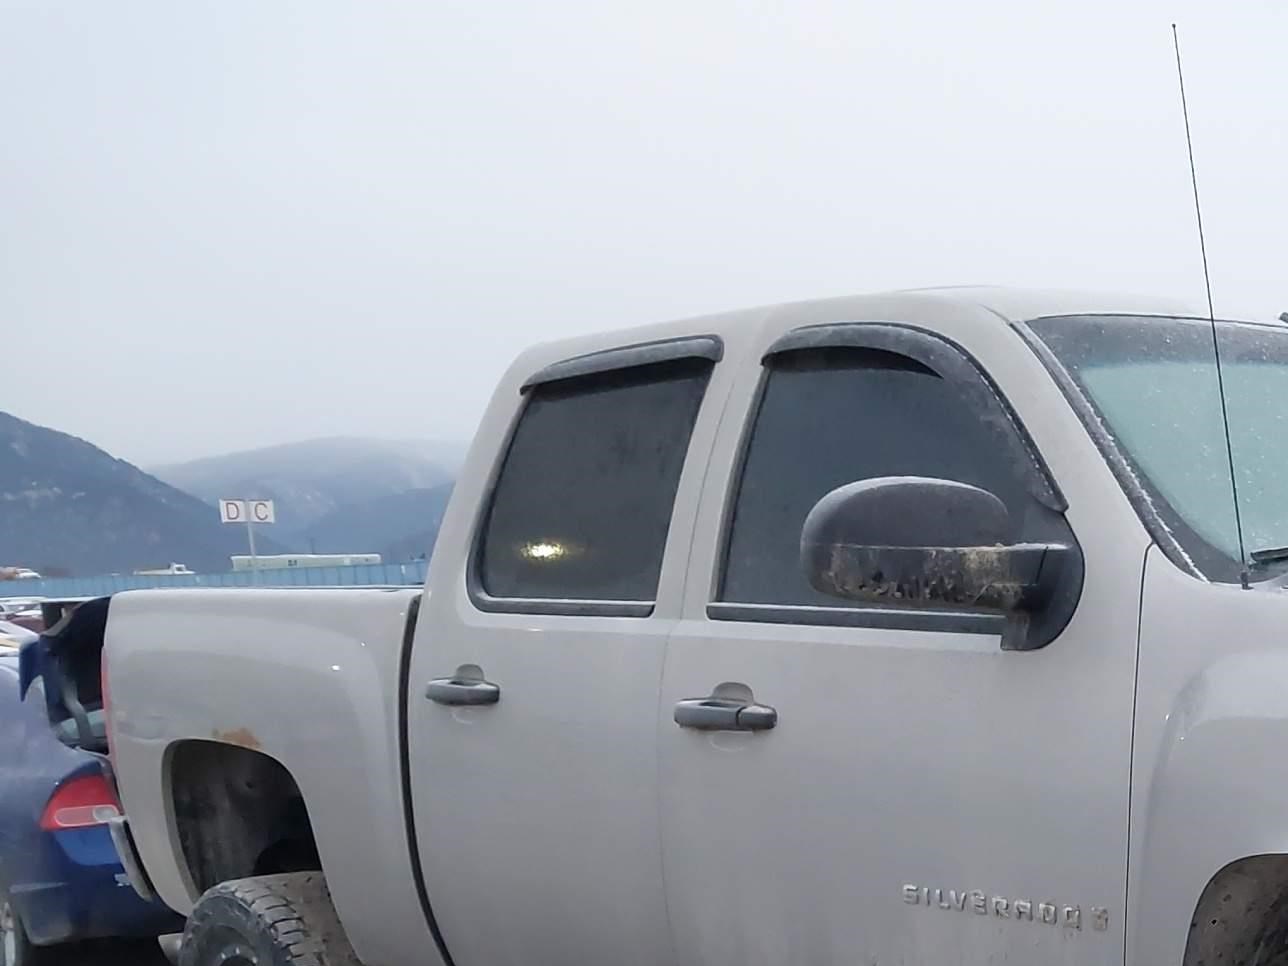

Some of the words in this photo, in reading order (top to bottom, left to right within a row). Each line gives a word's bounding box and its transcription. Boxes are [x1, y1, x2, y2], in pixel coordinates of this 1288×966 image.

[225, 502, 240, 520] D
[254, 502, 269, 521] C
[903, 883, 1082, 931] SILVERADO
